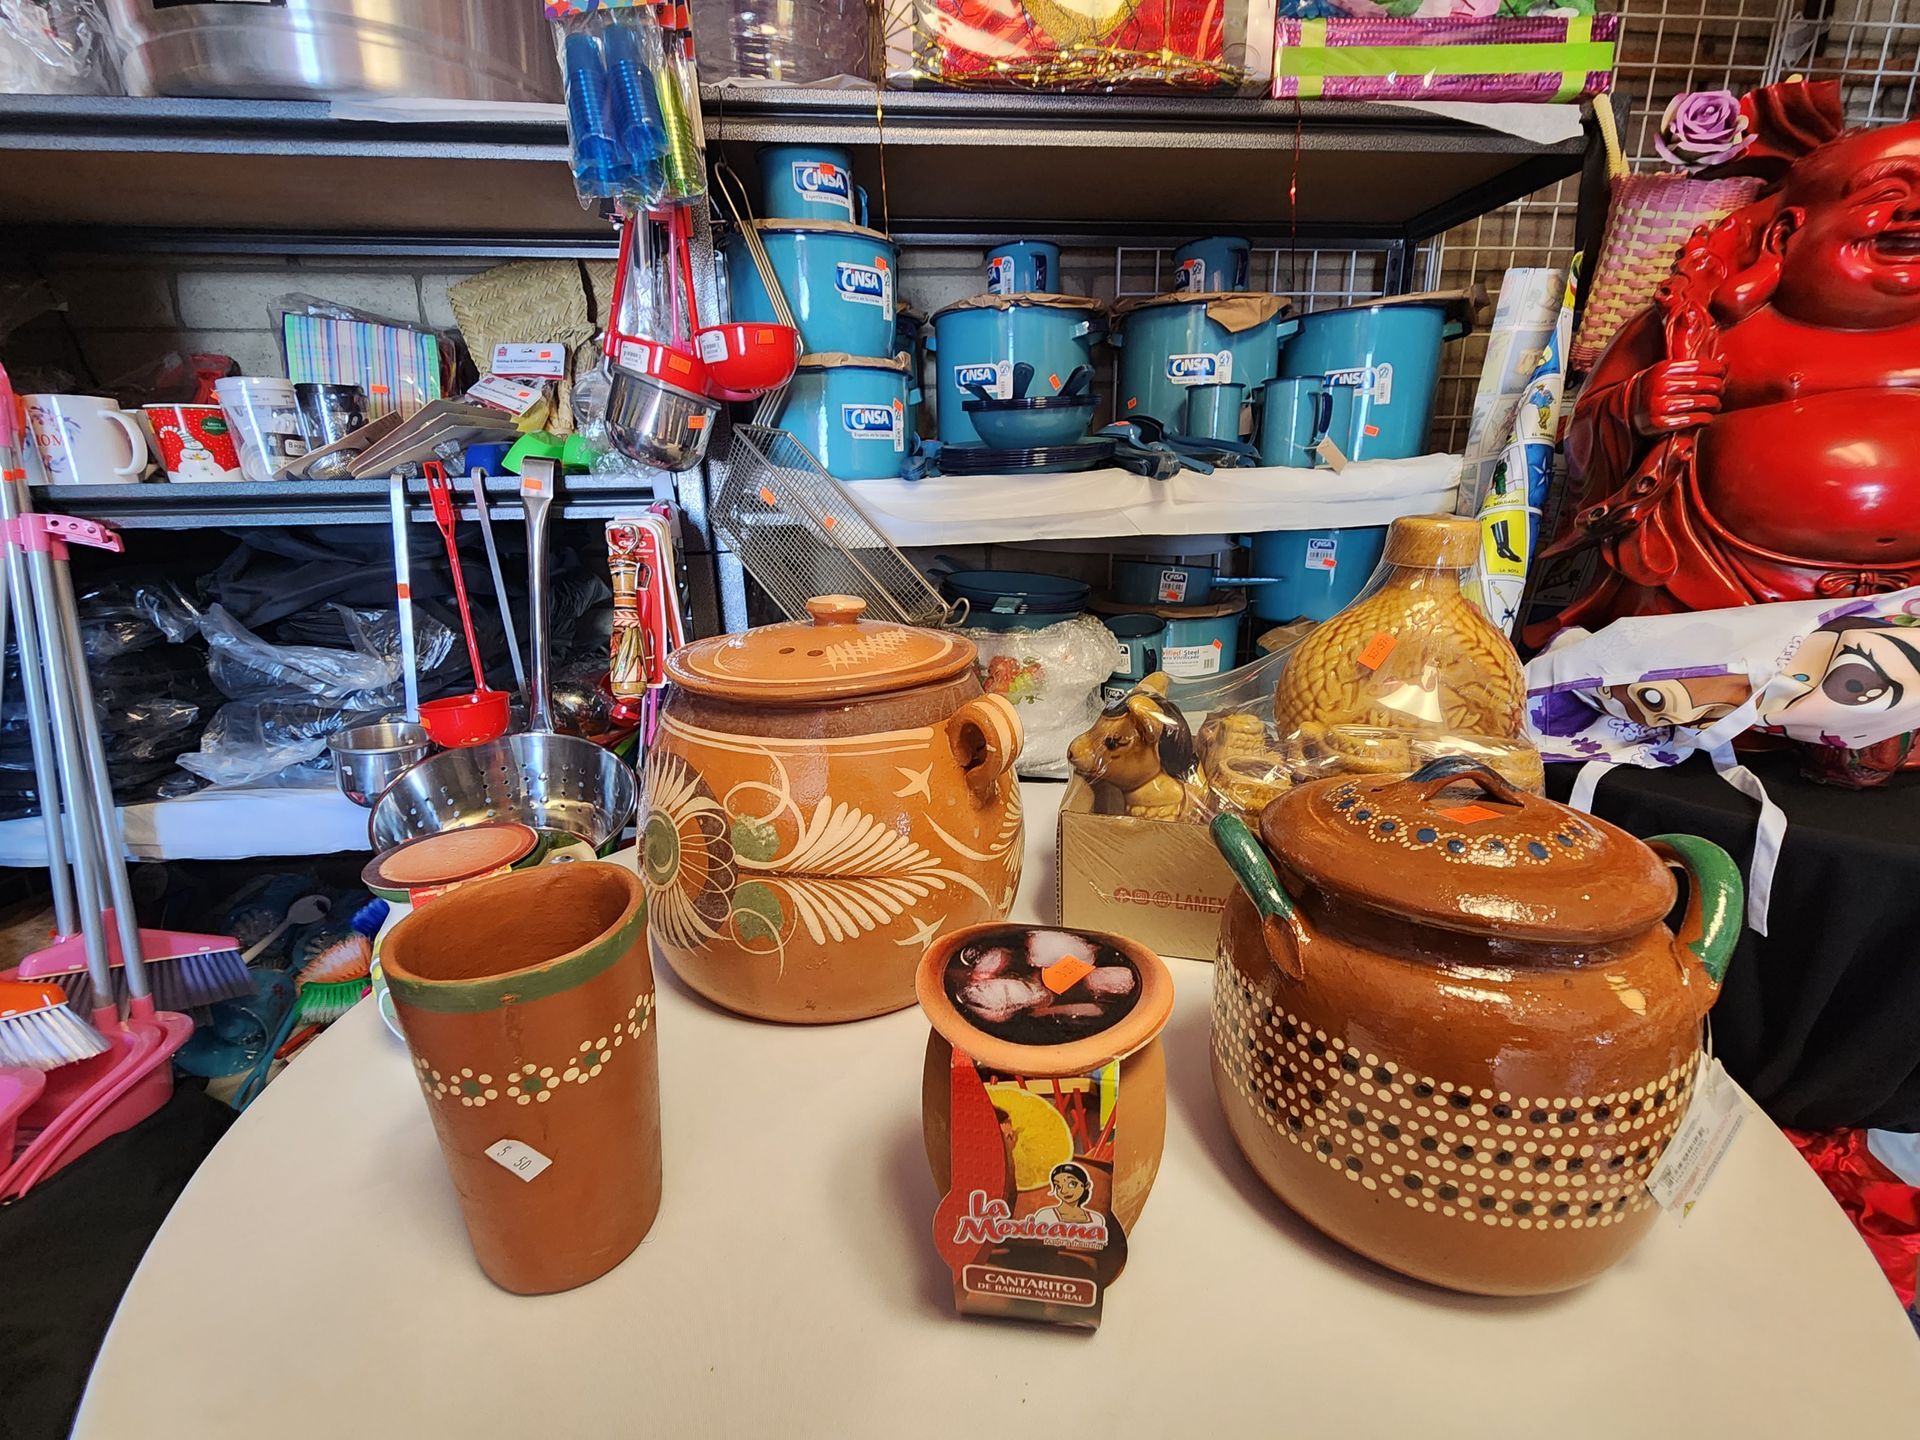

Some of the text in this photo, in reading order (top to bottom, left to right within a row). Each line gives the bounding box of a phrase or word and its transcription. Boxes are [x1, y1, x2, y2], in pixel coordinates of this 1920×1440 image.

[969, 1189, 1011, 1219] La
[953, 1216, 1109, 1244] Mexicana
[977, 1282, 1084, 1302] DE BARRO NATURAL
[984, 1273, 1077, 1294] CANTARITO
